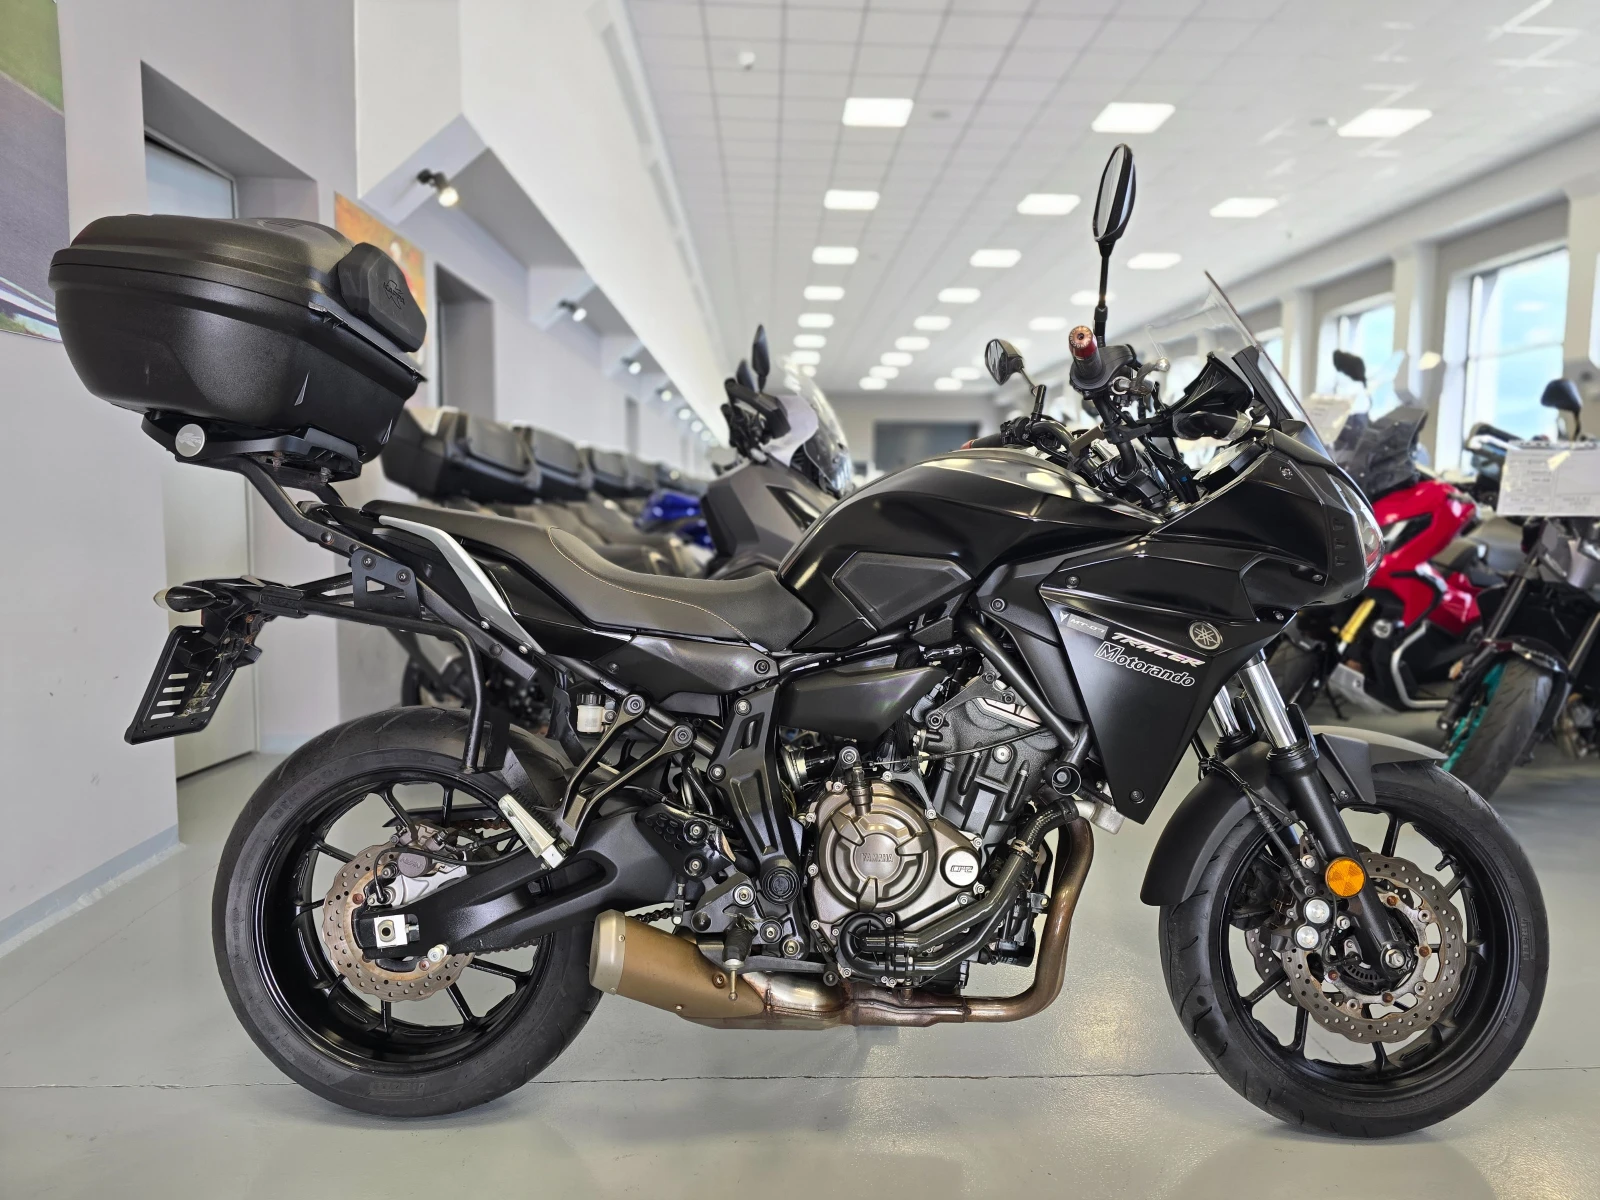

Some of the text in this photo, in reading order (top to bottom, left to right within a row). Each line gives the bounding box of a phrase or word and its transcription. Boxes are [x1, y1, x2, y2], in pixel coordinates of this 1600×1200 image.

[1094, 641, 1196, 687] Motorando
[1111, 632, 1206, 667] TRACER
[861, 853, 894, 863] YAMAHA
